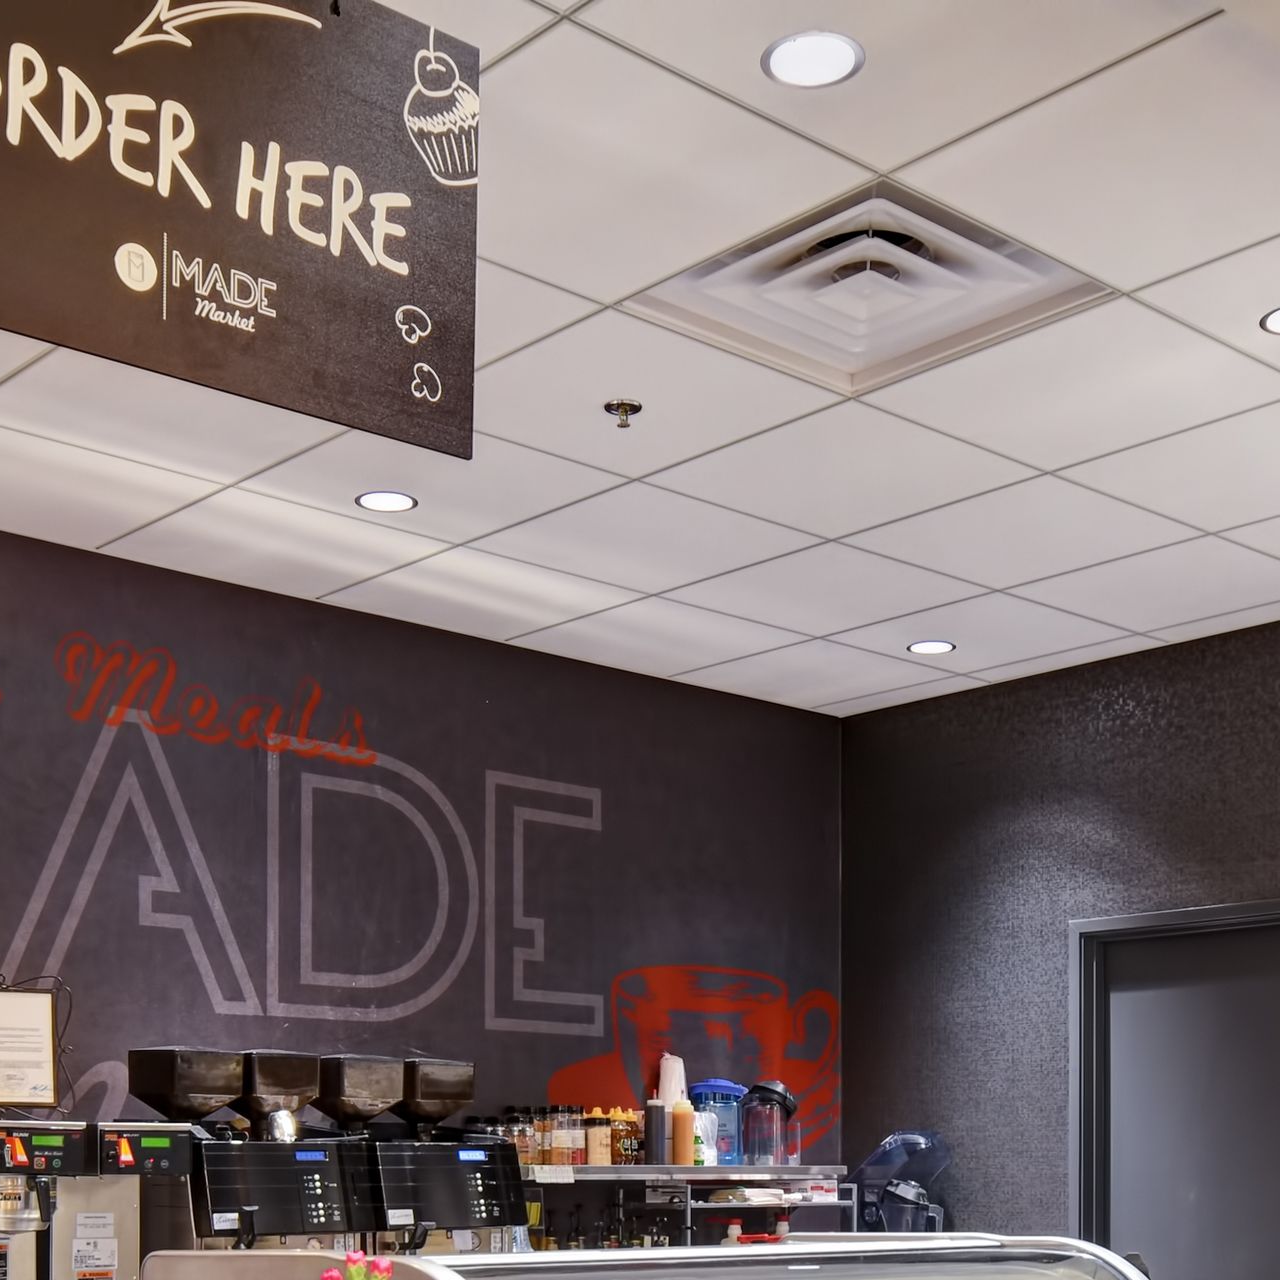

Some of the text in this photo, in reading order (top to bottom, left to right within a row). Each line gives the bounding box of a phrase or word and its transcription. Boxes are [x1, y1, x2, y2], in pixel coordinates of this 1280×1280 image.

[235, 140, 412, 275] HERE
[172, 249, 277, 318] MADE
[194, 298, 256, 333] Market
[54, 631, 378, 767] Meals
